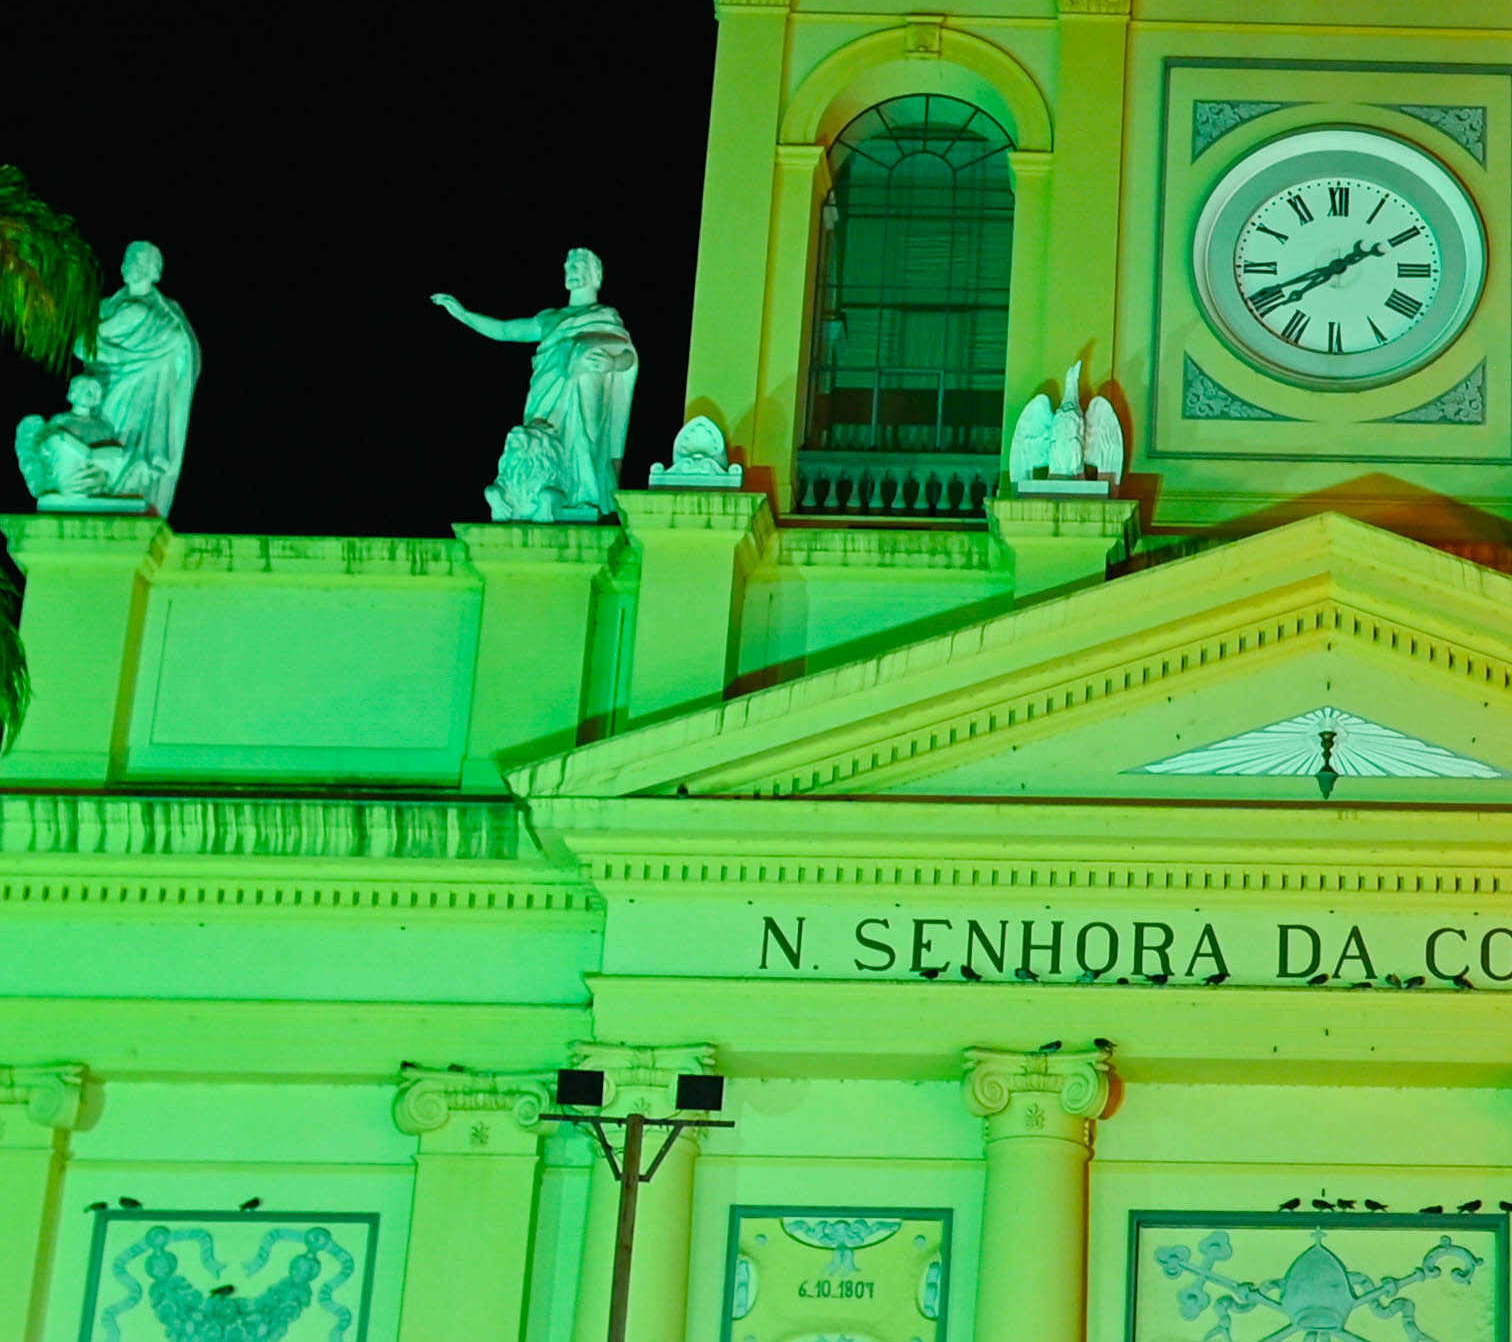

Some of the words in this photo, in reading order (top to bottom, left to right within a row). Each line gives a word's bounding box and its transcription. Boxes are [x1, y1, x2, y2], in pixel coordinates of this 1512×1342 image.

[1287, 194, 1314, 226] XI
[1327, 187, 1349, 217] XII
[1255, 222, 1289, 245] X
[1387, 225, 1421, 248] II
[1397, 262, 1431, 278] III
[1281, 309, 1311, 343] VII
[1328, 321, 1344, 354] VI
[759, 916, 820, 971] N.
[854, 918, 1230, 977] SENHORA
[1275, 924, 1376, 979] DA
